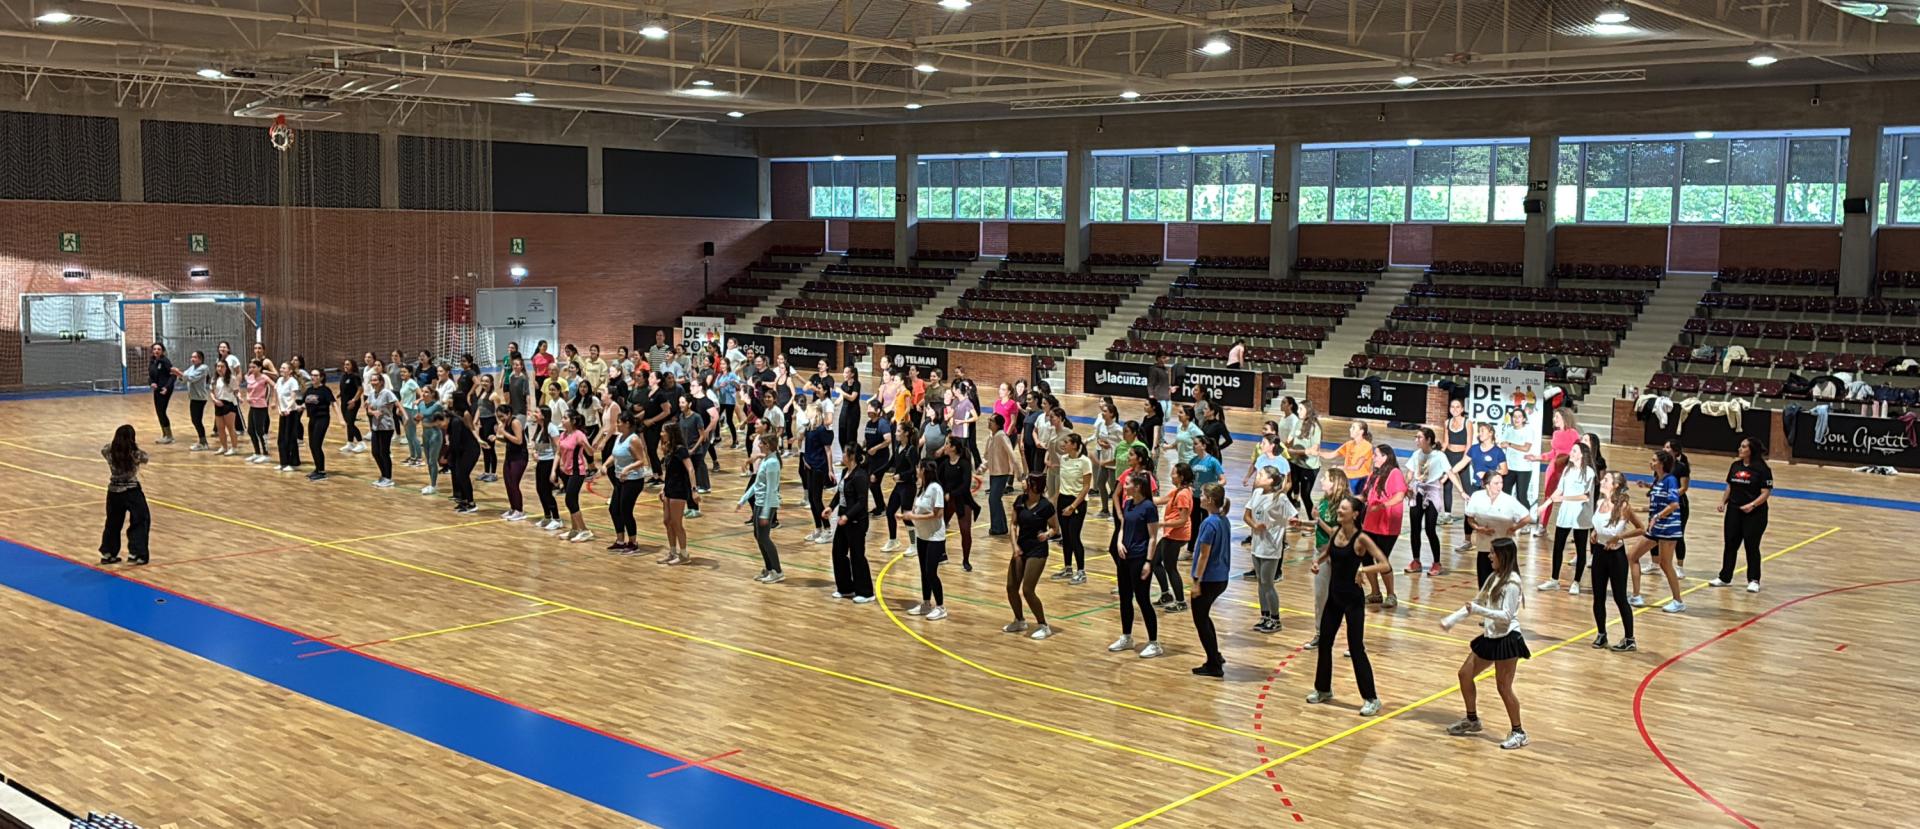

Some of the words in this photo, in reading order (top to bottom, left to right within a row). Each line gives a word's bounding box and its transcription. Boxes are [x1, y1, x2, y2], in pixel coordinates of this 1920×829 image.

[684, 327, 700, 339] DE
[789, 346, 808, 356] ostiz
[905, 355, 938, 366] TELMAN
[1107, 371, 1148, 386] lacunza
[1184, 373, 1241, 389] campus
[1473, 375, 1500, 383] SEMANA
[1501, 376, 1513, 385] DEL
[1182, 383, 1223, 399] he
[1383, 390, 1393, 402] la
[1473, 383, 1502, 402] DE
[1356, 403, 1393, 416] cabaña
